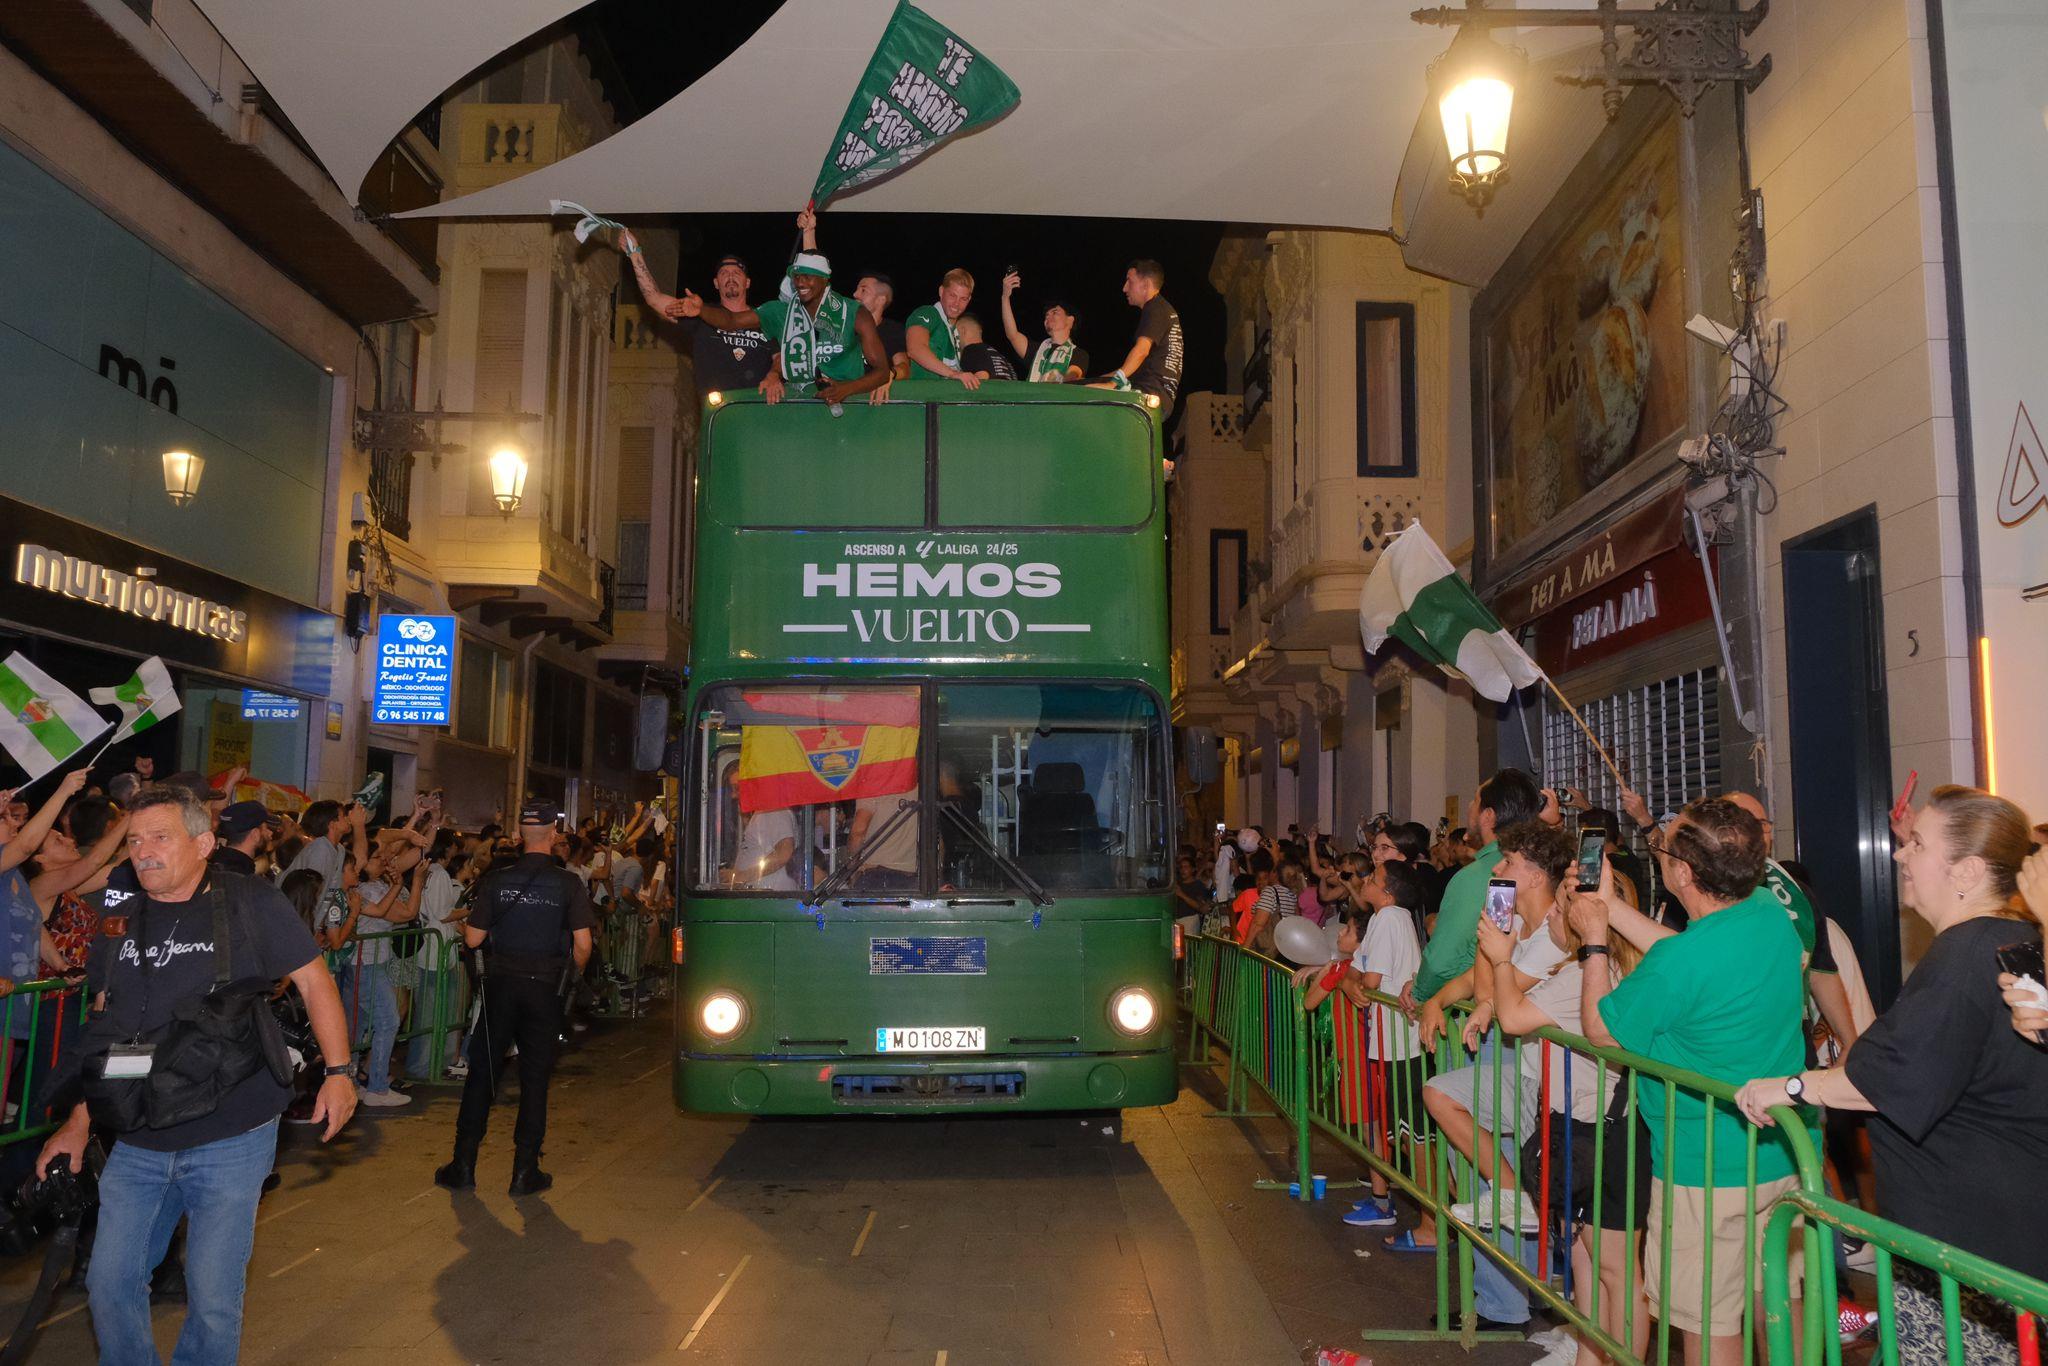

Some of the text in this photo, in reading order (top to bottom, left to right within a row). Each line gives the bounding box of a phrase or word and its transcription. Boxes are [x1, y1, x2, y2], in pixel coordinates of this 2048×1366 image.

[723, 336, 758, 348] VUELTO
[844, 543, 1018, 556] ASCENSO A LALIGA 24/25
[803, 562, 1062, 598] HEMOS
[851, 608, 1020, 643] VUELTO
[1907, 629, 1920, 657] 5
[382, 656, 446, 669] DENTAL
[380, 671, 414, 682] Rogelio
[390, 711, 445, 721] 96 545 17 48
